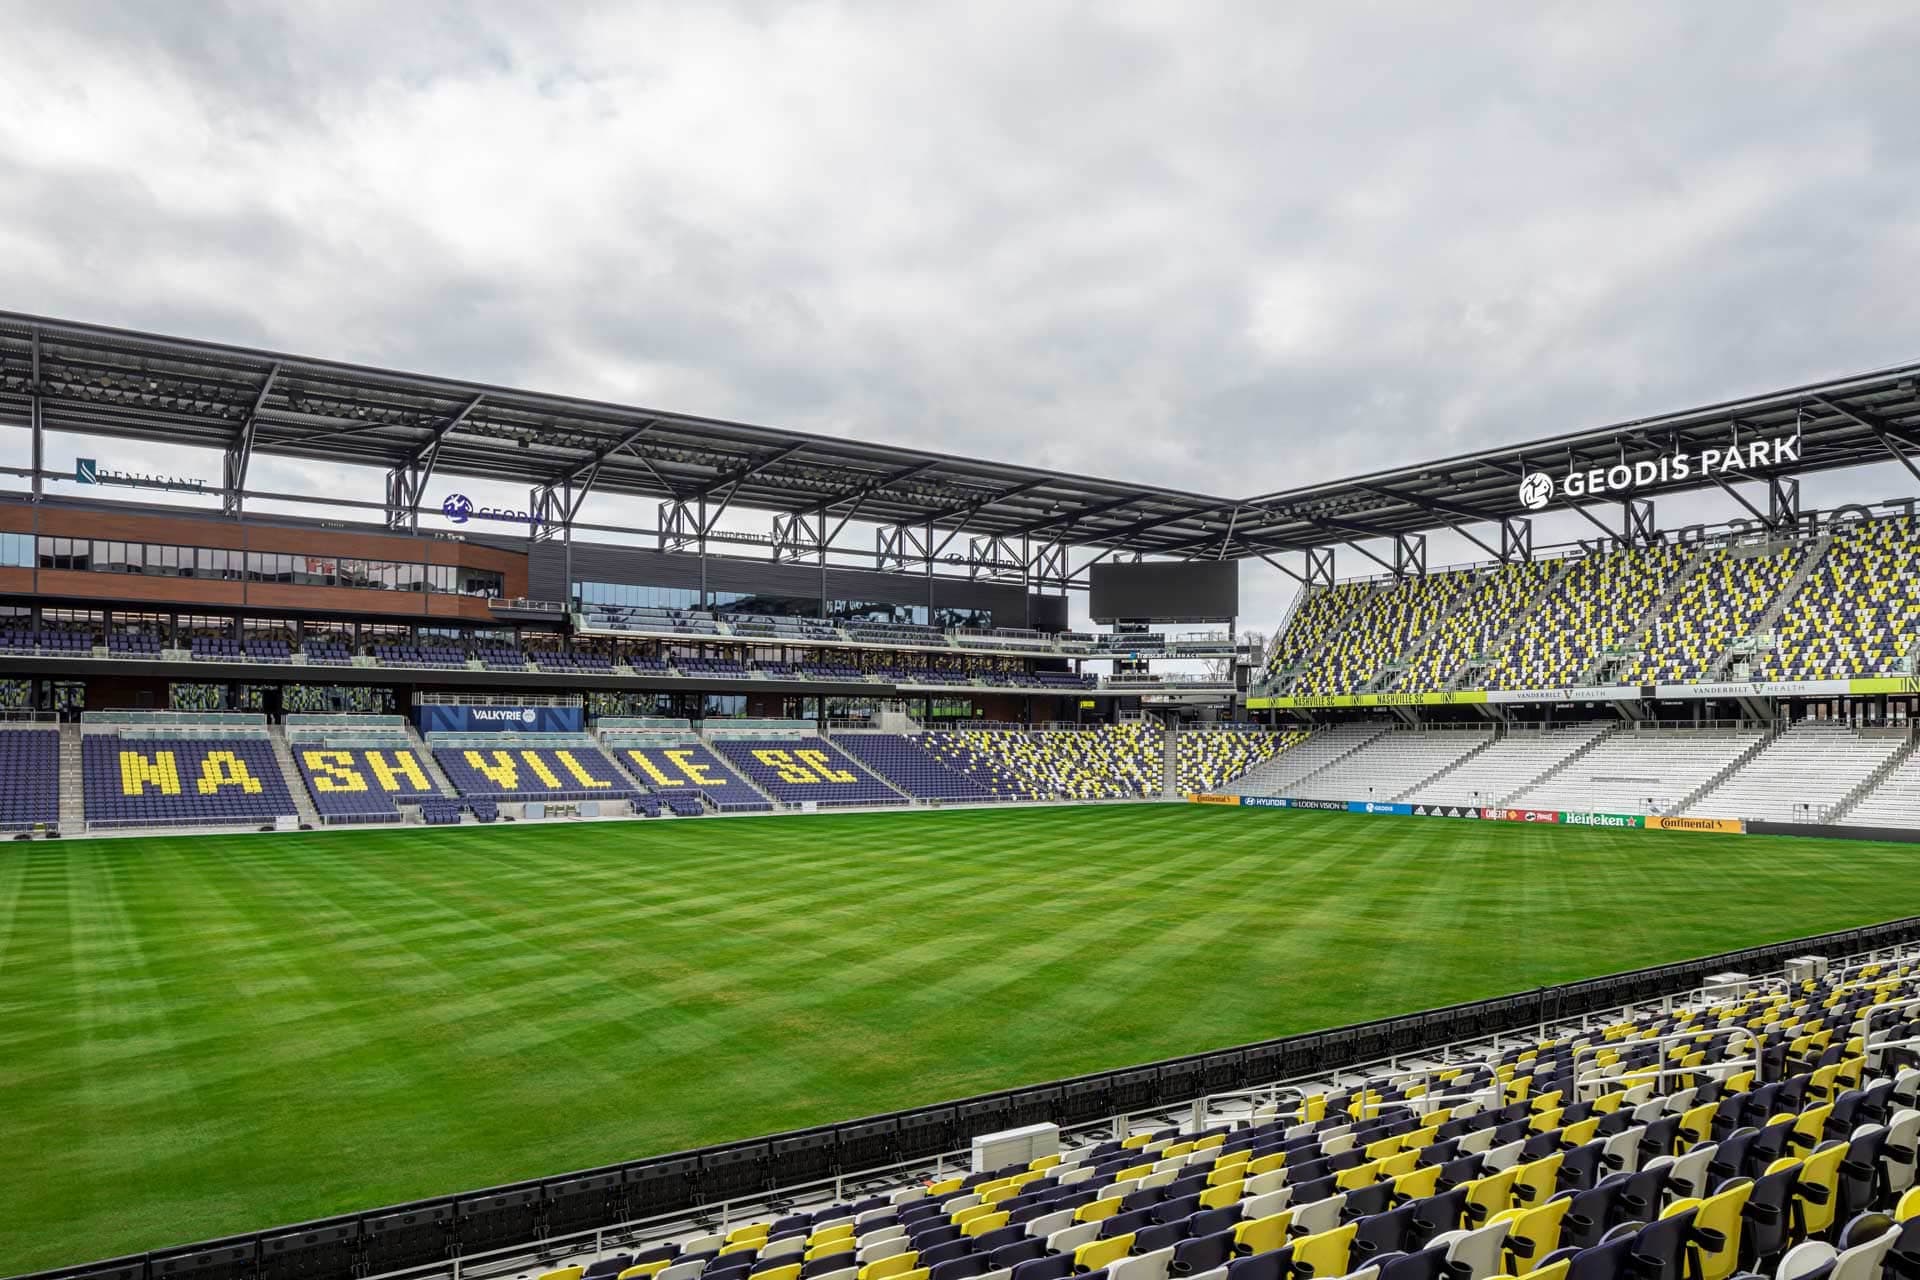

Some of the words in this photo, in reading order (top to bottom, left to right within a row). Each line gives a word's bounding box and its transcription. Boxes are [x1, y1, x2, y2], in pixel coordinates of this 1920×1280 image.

[1563, 454, 1689, 496] GEODIS
[1702, 435, 1799, 475] PARK
[1693, 687, 1748, 695] VANDERBILT
[1294, 697, 1325, 707] NASHVILLE
[1326, 696, 1335, 706] SC
[1377, 694, 1413, 705] NASHVILLE
[1415, 693, 1424, 704] SC
[473, 709, 521, 721] VALKYRIE
[752, 750, 858, 784] SC
[1256, 799, 1287, 807] HYUNDAI
[1566, 812, 1624, 826] Heineken
[1660, 817, 1715, 829] Continental
